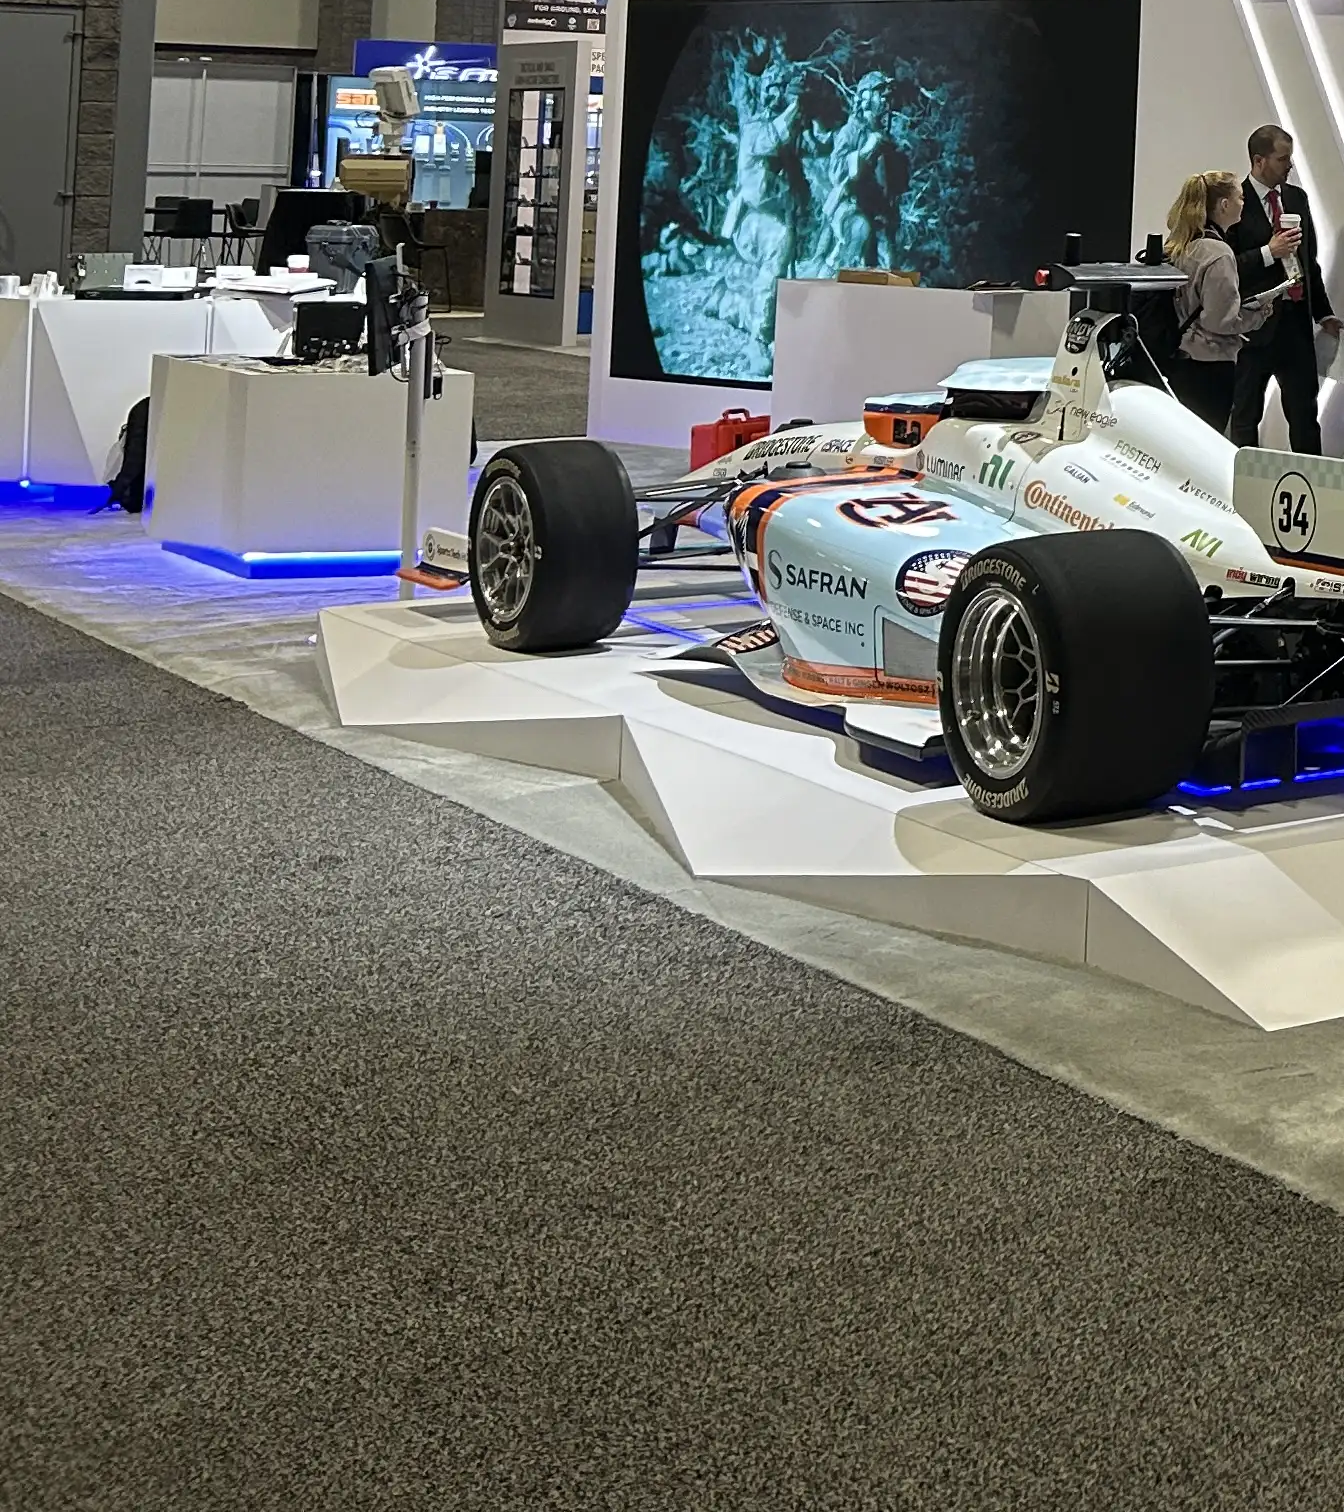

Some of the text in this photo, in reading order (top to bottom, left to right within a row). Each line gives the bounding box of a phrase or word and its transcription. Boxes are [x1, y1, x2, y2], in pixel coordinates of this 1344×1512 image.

[1278, 491, 1309, 536] 34
[786, 563, 869, 600] SAFRAN
[960, 558, 1027, 592] BRIDGESTONE
[812, 613, 842, 633] SPACE
[844, 622, 865, 637] INC
[964, 772, 1029, 809] BRIDGESTONE
